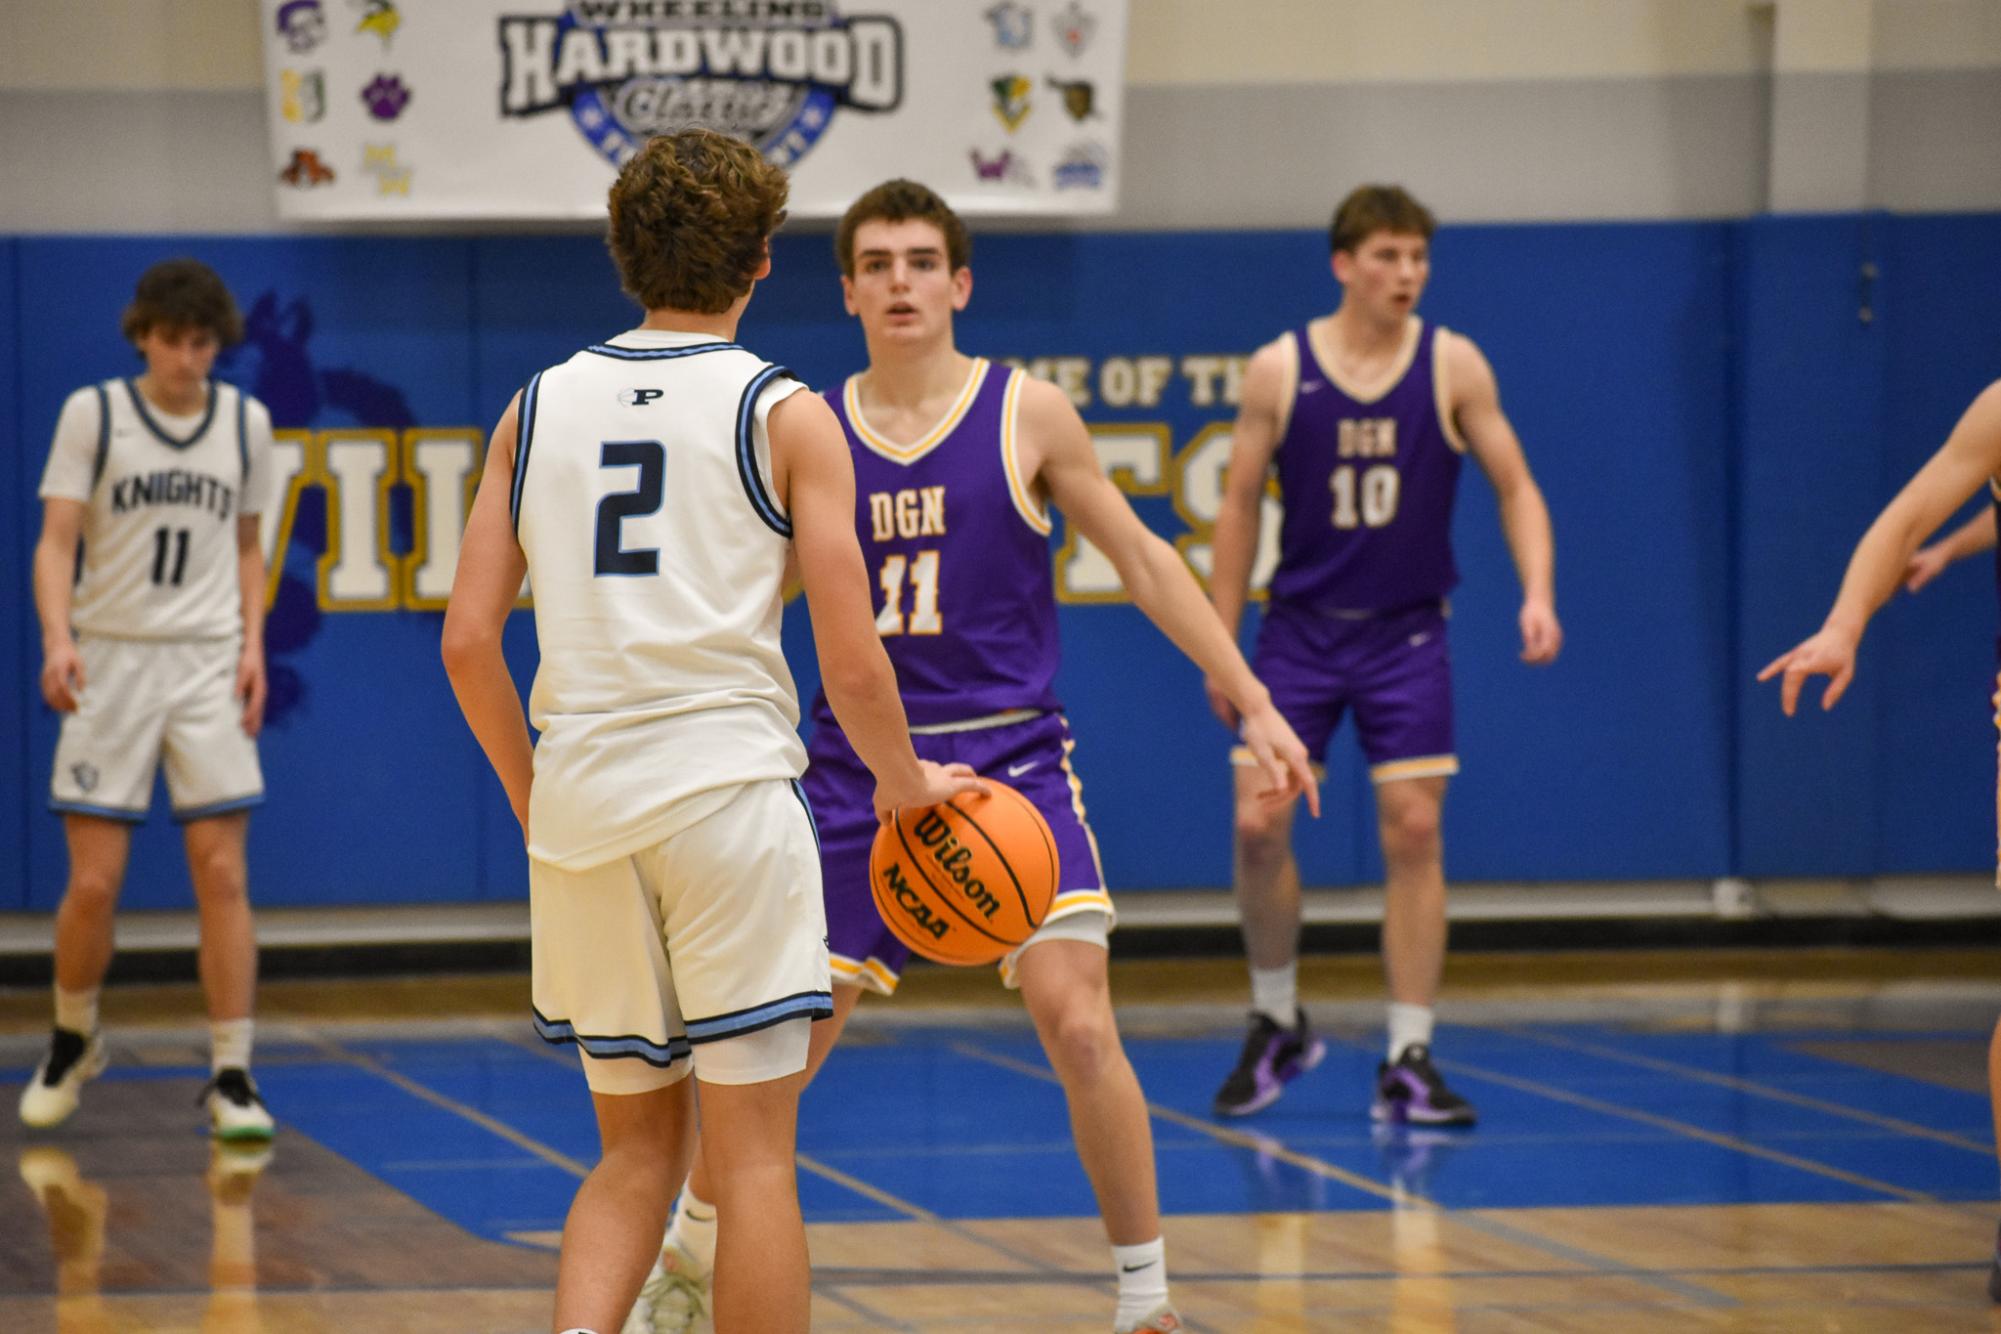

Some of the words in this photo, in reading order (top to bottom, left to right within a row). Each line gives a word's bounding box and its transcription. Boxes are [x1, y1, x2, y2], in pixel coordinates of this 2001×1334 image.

[579, 0, 823, 18] WHEELING
[502, 17, 901, 112] HARDWOOD
[631, 388, 665, 406] P
[1101, 356, 1173, 407] OF
[111, 469, 232, 521] KNIGHTS
[593, 439, 667, 578] 2
[869, 486, 947, 543] DGN
[1328, 463, 1401, 531] 10
[150, 524, 191, 588] 11
[875, 549, 944, 638] 11
[913, 808, 1001, 919] Wilson
[883, 862, 950, 940] NCAA
